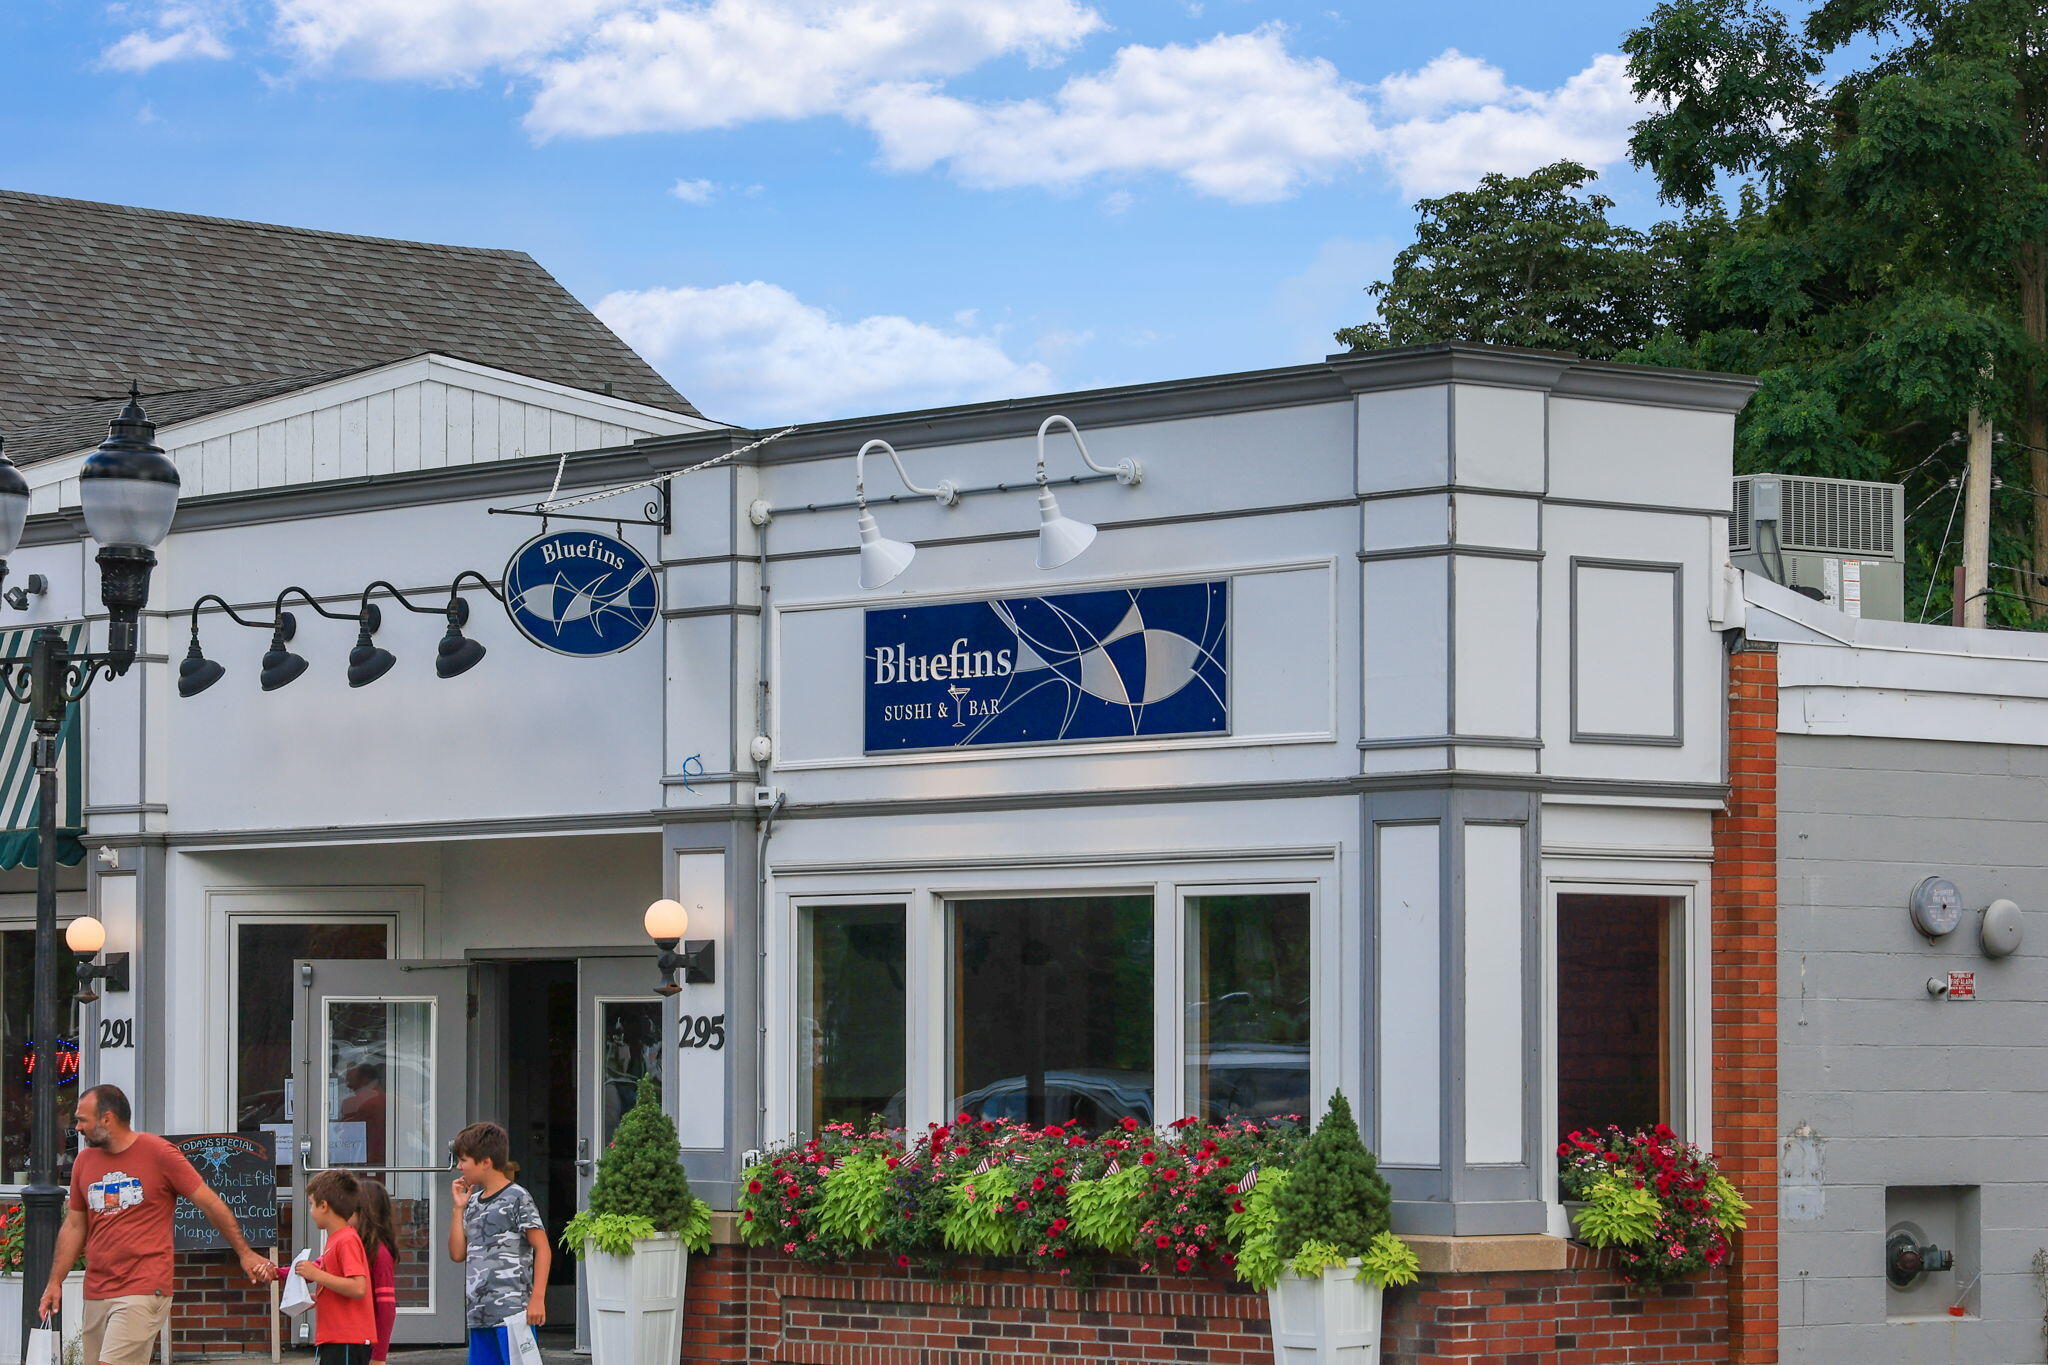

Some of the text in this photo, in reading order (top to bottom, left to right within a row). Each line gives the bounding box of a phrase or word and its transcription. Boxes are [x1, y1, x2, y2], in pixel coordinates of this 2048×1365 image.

[540, 539, 625, 570] Bluefins
[874, 637, 1012, 685] Bluefins
[884, 698, 1001, 722] SUSHI & BAR
[100, 1018, 135, 1048] 291
[679, 1013, 725, 1051] 295
[215, 1138, 254, 1151] SPECIAL
[255, 1169, 275, 1186] fish
[174, 1207, 205, 1219] Soft
[248, 1200, 276, 1218] Crab
[174, 1224, 220, 1244] Mango
